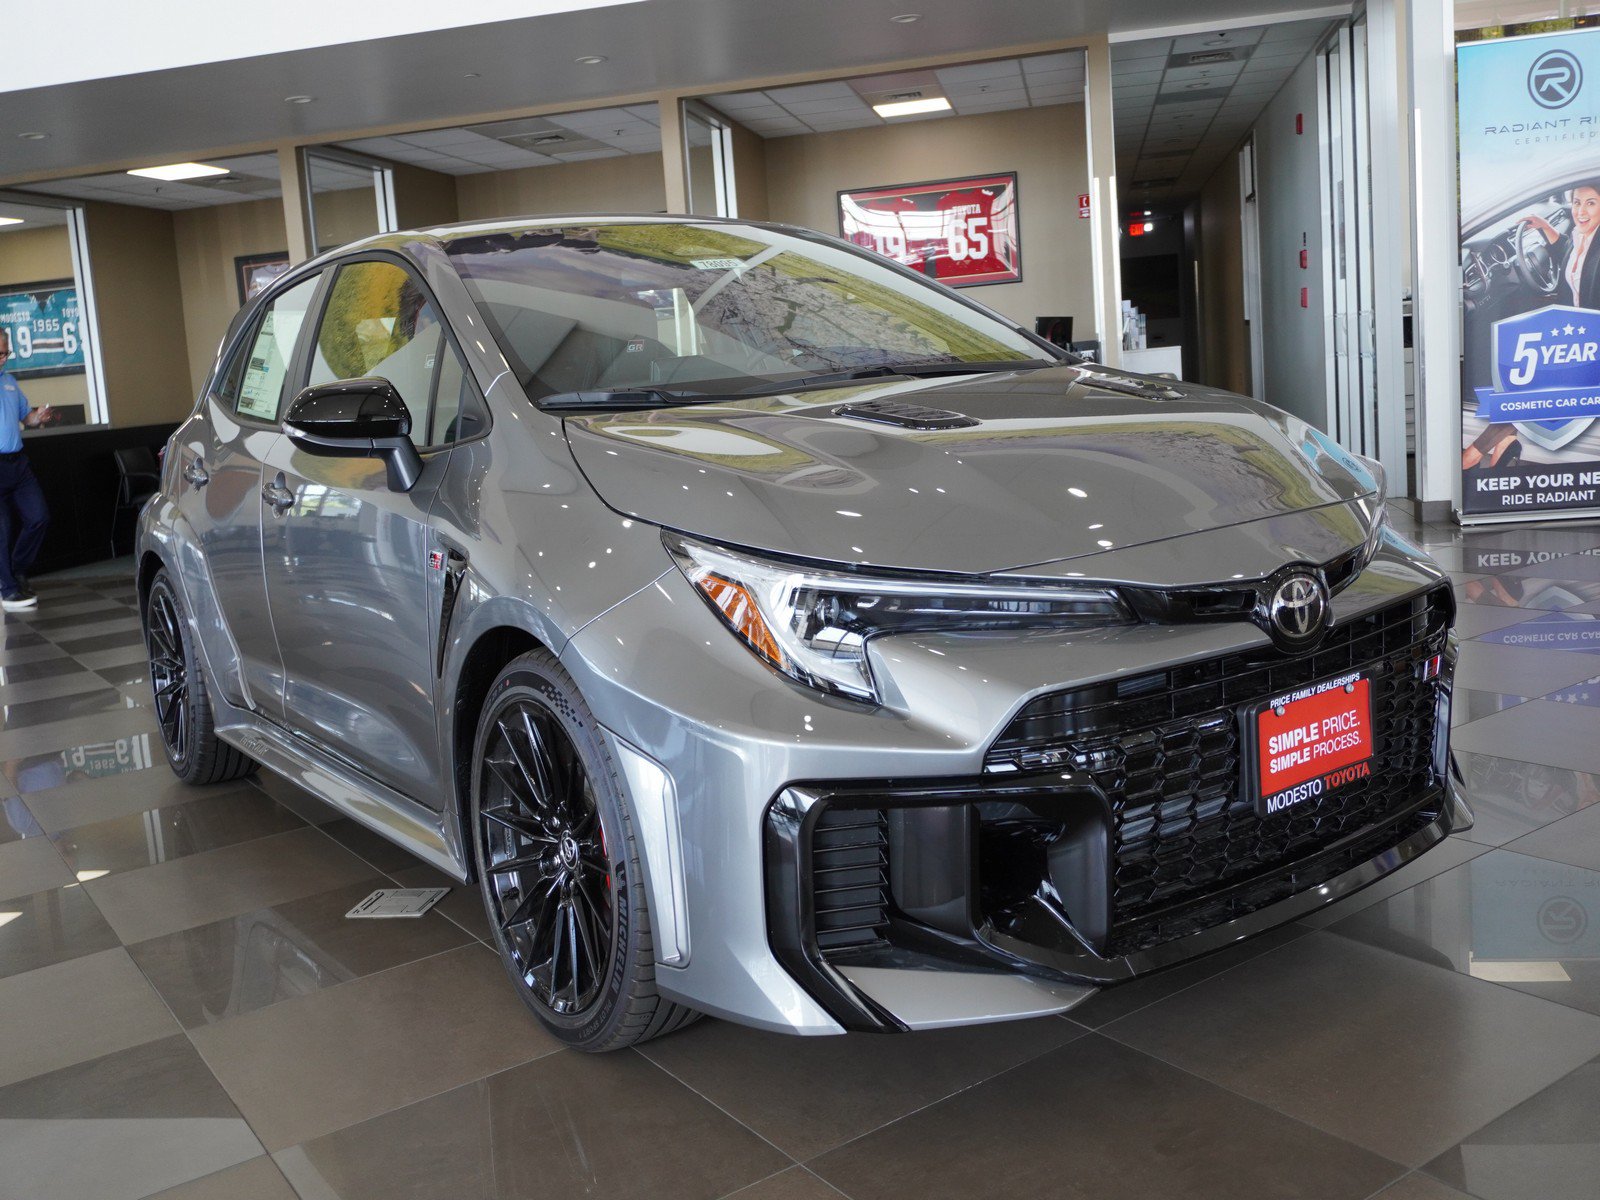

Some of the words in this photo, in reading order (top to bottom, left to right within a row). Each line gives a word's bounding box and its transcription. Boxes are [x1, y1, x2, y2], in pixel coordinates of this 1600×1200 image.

[1484, 118, 1571, 135] RADIANT
[1579, 115, 1597, 125] RI
[1514, 130, 1597, 146] CERTIFIED
[947, 216, 989, 262] 65
[33, 317, 60, 333] 1965
[1509, 332, 1543, 386] 5
[1540, 341, 1598, 365] YEAR
[1500, 400, 1553, 411] COSMETIC
[1555, 398, 1577, 408] CAR
[1580, 396, 1600, 406] CAR
[1476, 476, 1521, 492] KEEP
[1525, 473, 1574, 489] YOUR
[1579, 471, 1600, 486] NE
[1502, 493, 1533, 506] RIDE
[1536, 489, 1596, 504] RADIANT
[1270, 694, 1291, 709] PRICE
[1291, 687, 1316, 702] FAMILY
[1316, 672, 1360, 694] DEALERSHIPS
[1269, 722, 1319, 755] SIMPLE
[1322, 709, 1361, 737] PRICE.
[1270, 746, 1311, 774] SIMPLE
[1313, 730, 1362, 759] PROCESS.
[1267, 778, 1322, 814] MODESTO
[1324, 761, 1371, 791] TOYOTA
[611, 896, 629, 995] MICHELIN
